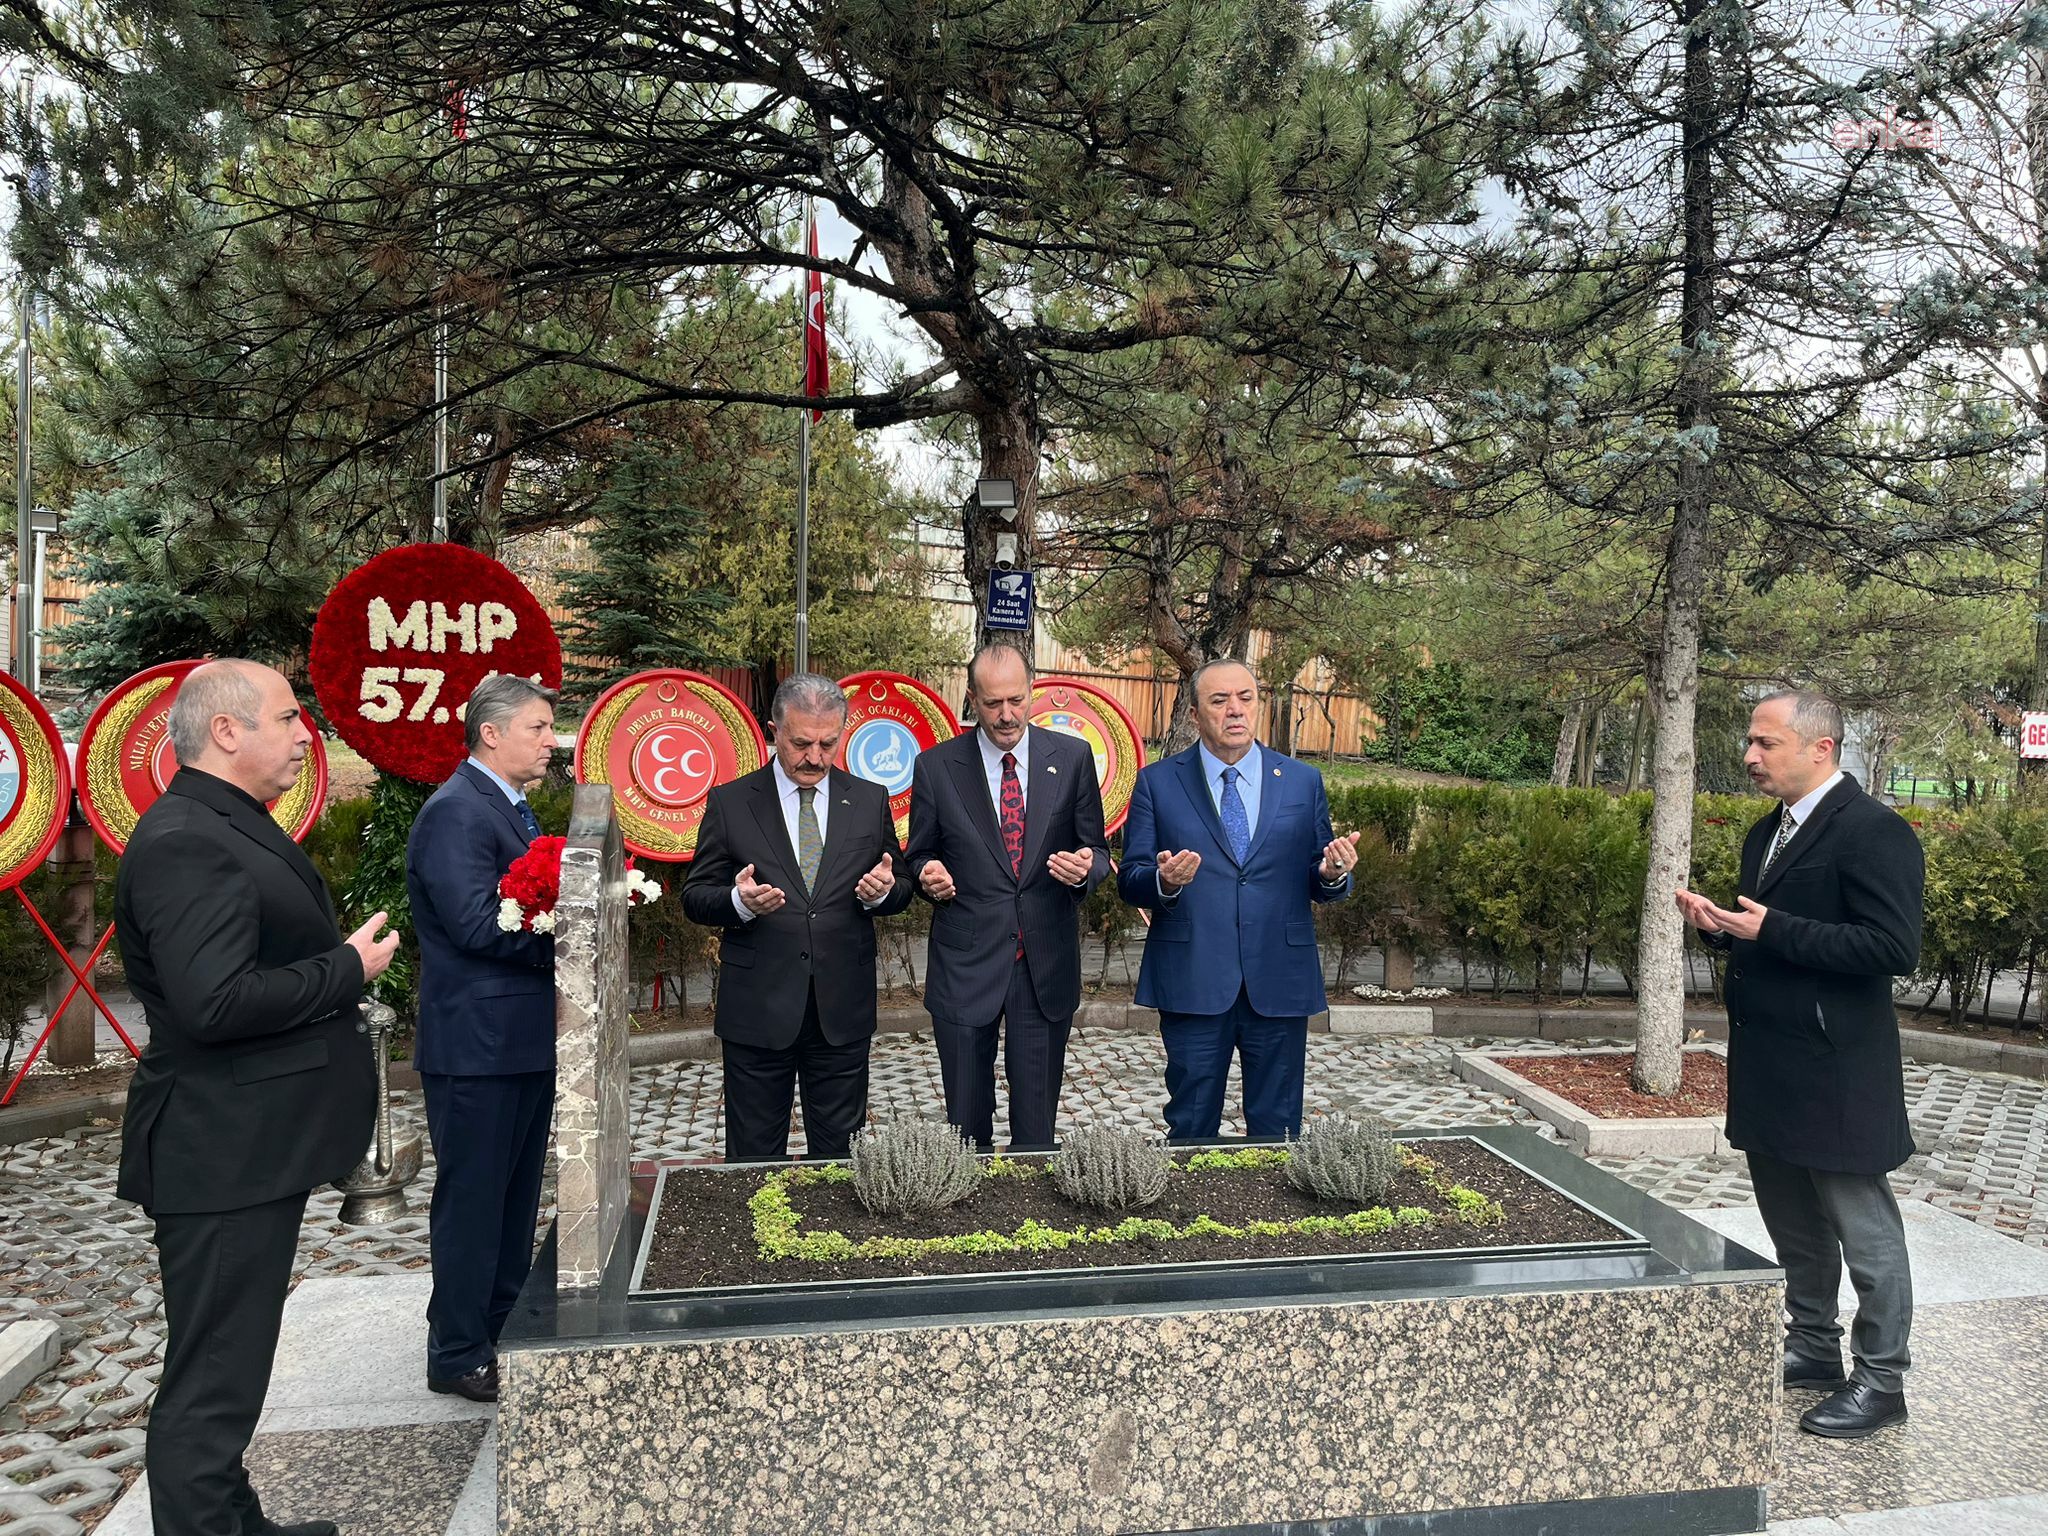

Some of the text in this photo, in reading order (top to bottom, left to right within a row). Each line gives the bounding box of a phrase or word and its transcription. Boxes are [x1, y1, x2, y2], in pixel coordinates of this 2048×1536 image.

[992, 607, 1014, 615] Kamera
[1006, 599, 1020, 607] Saat
[367, 596, 517, 653] MHP
[626, 708, 664, 736] DEVLET
[868, 704, 919, 728] OCAKLARI
[623, 786, 647, 810] MHP
[649, 807, 687, 822] GENEL
